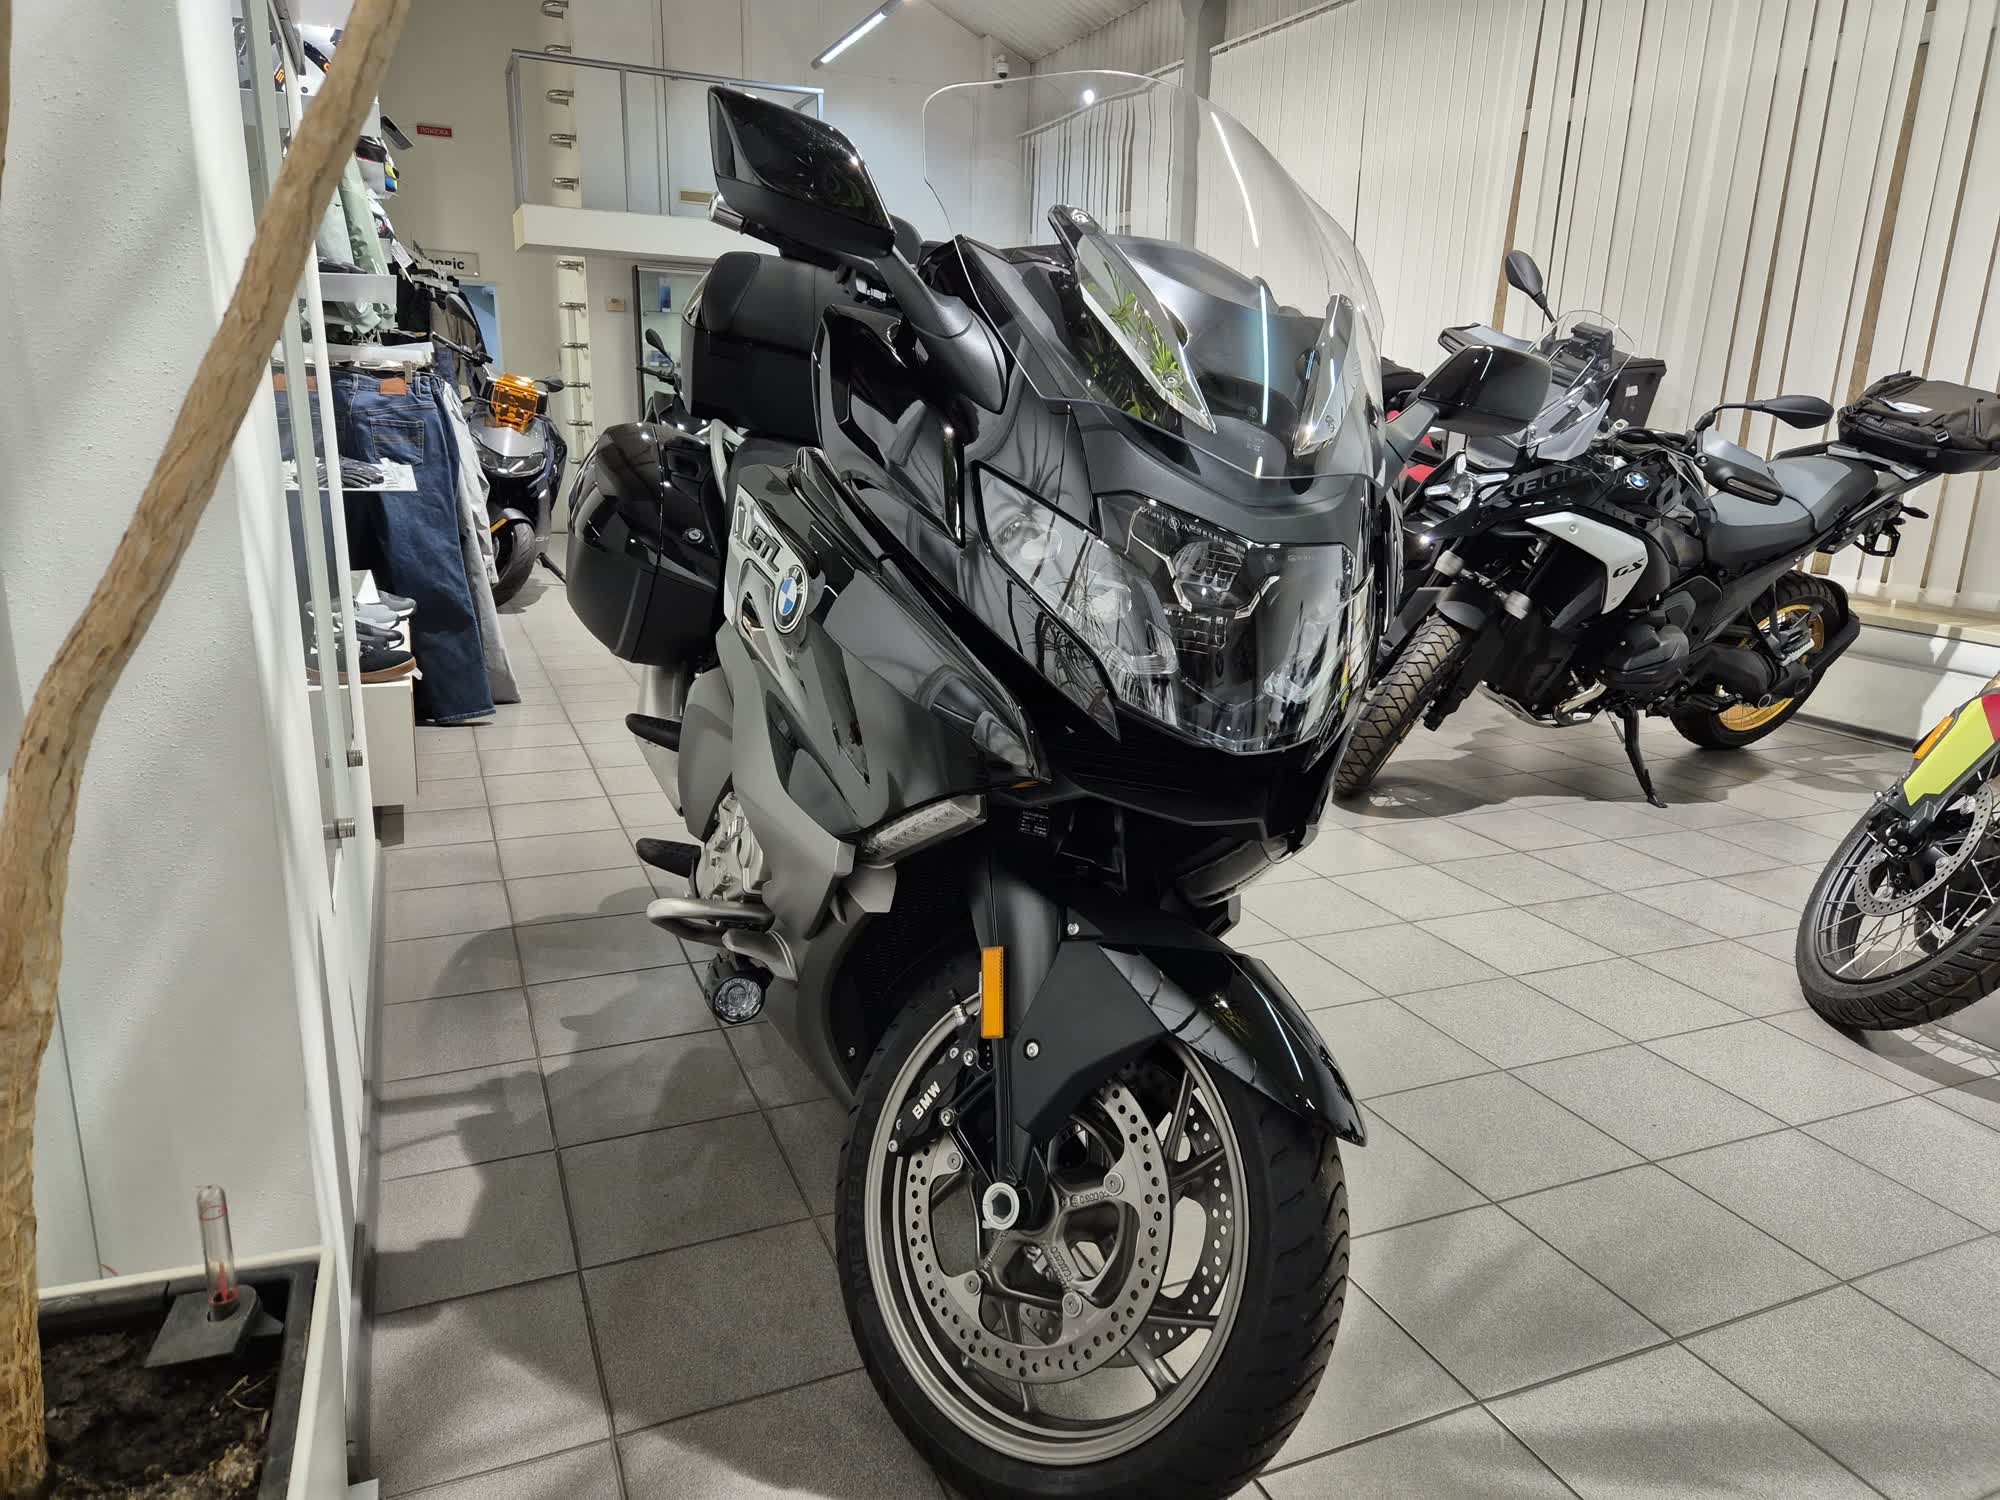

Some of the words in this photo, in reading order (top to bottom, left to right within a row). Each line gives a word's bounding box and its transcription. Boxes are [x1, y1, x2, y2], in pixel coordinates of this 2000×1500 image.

[748, 525, 781, 573] GTL
[1612, 557, 1646, 578] GS
[912, 1080, 941, 1120] BMW
